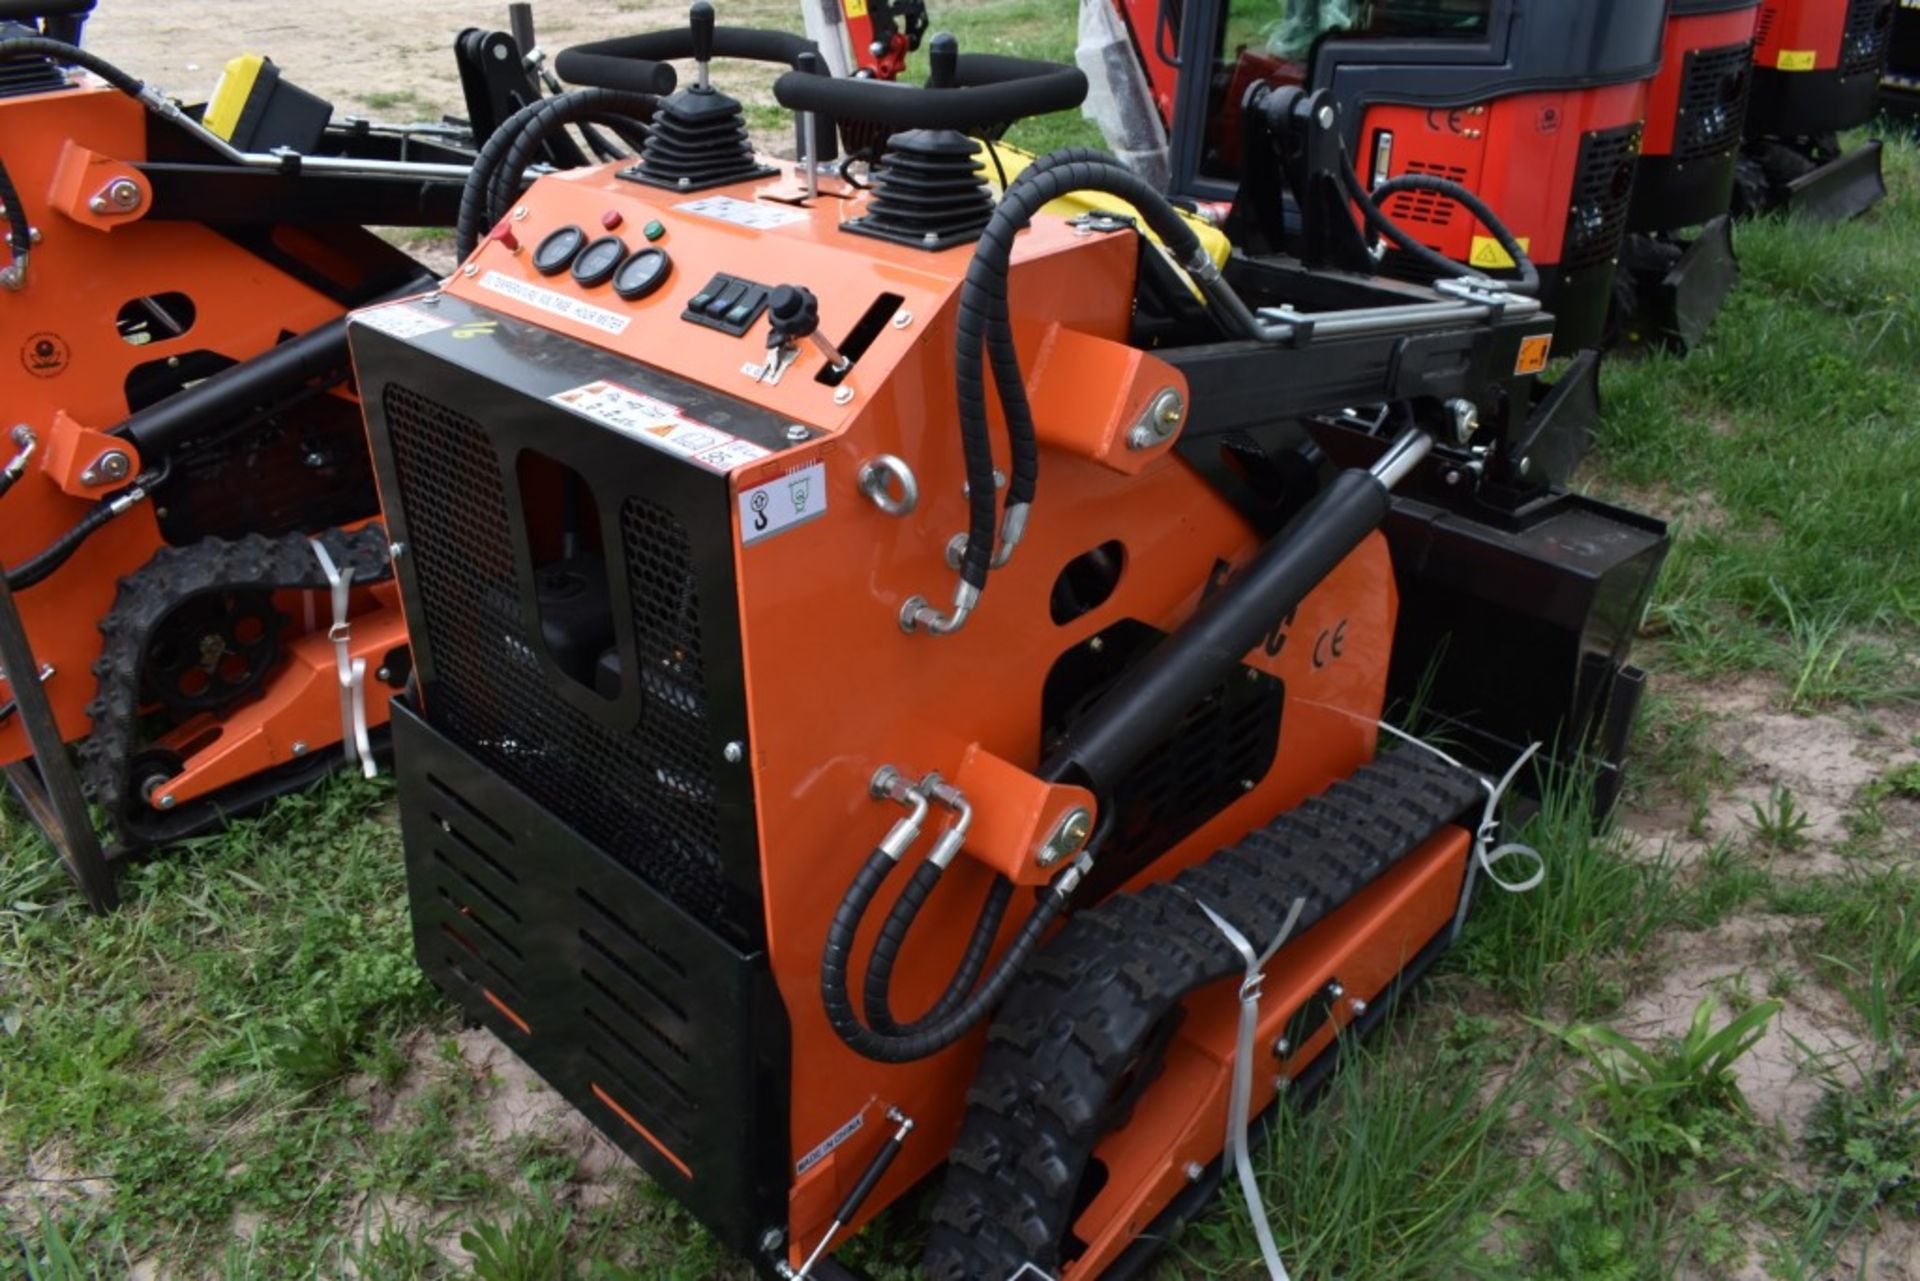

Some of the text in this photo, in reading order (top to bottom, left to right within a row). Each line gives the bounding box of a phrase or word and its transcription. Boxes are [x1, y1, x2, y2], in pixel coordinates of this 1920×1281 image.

[538, 292, 573, 312] VOLTAGE
[576, 307, 597, 321] HOUR
[598, 313, 625, 330] METER
[1312, 618, 1348, 668] CE
[798, 1119, 860, 1172] MADE IN CHINA
